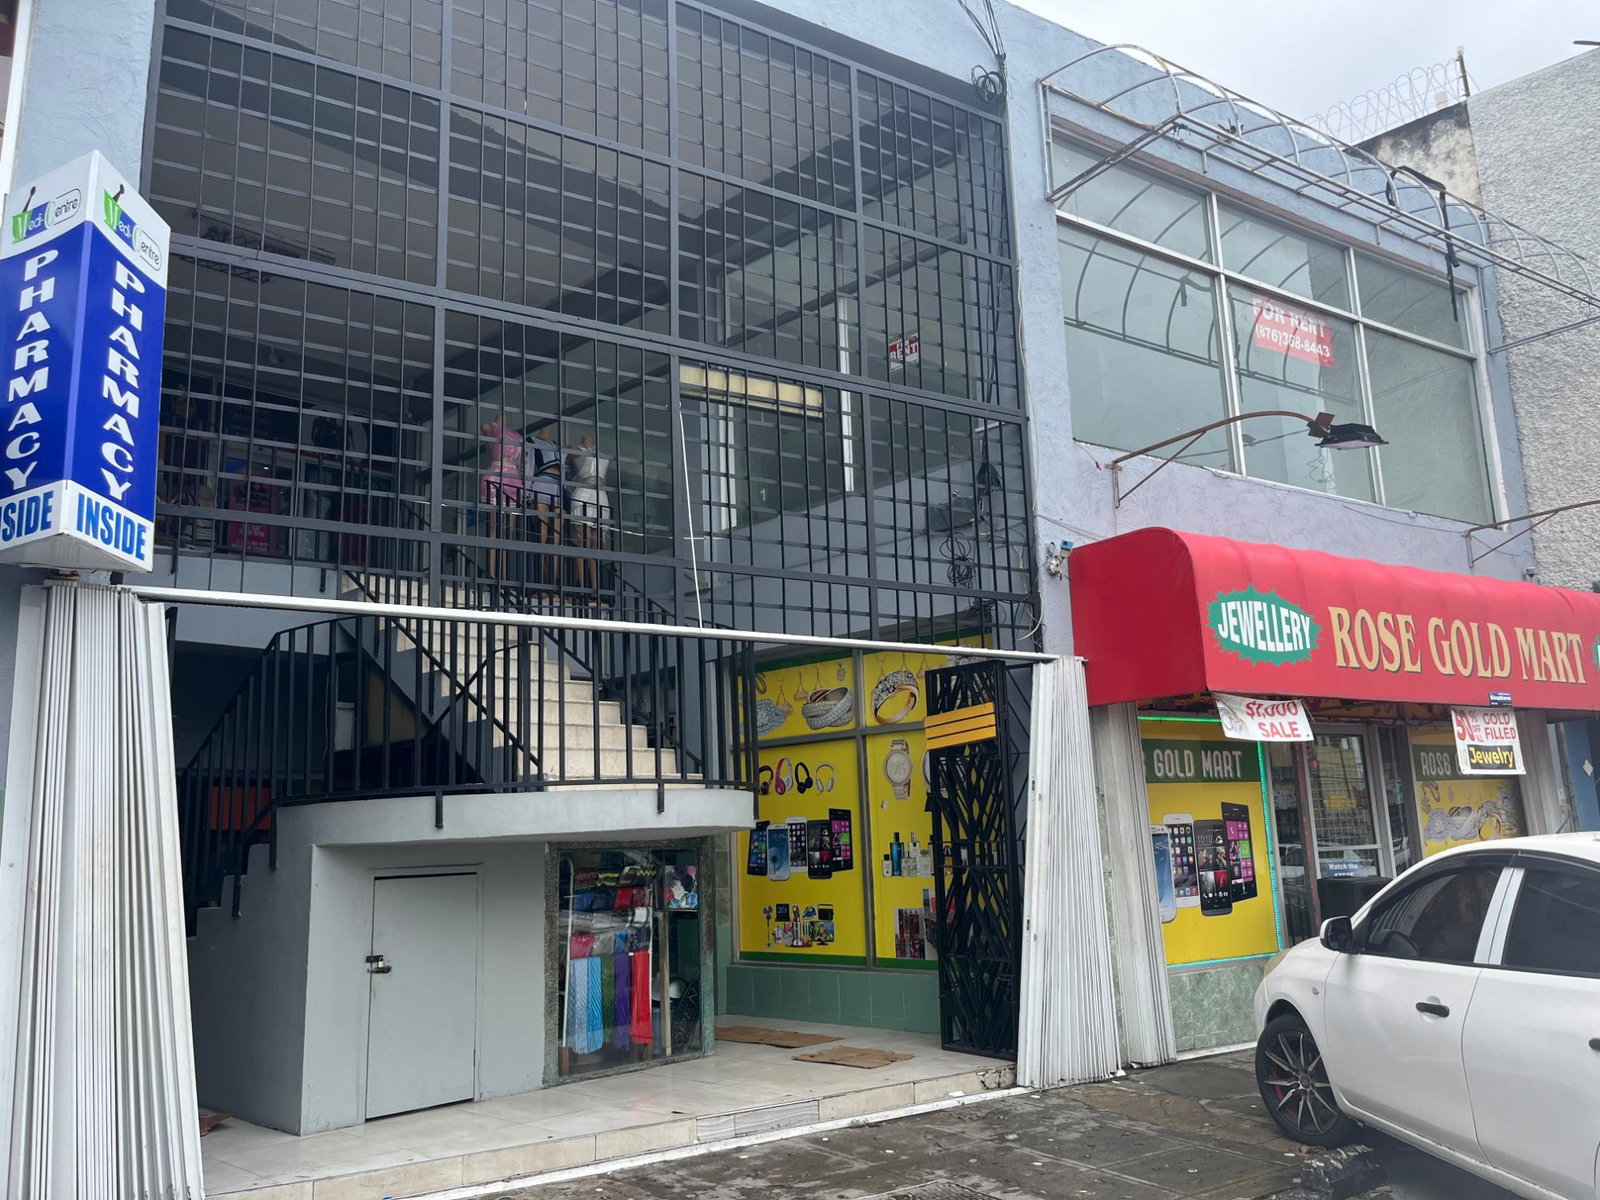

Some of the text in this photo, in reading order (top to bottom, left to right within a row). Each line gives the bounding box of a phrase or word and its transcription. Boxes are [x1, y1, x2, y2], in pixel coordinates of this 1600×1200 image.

[1252, 298, 1326, 338] FOR RENT
[5, 250, 59, 490] PHARMACY
[101, 260, 146, 501] PHARMACY
[0, 491, 54, 542] SIDE
[76, 492, 147, 561] INSIDE
[1217, 600, 1311, 652] JEWELLERY
[1327, 606, 1587, 684] ROSE GOLD MART
[1258, 721, 1301, 738] SALE
[1483, 712, 1511, 725] GOLD
[1484, 727, 1517, 740] FILLED
[1153, 749, 1195, 778] GOLD
[1201, 750, 1243, 779] MART
[1469, 746, 1514, 768] Jewelry
[1328, 862, 1347, 871] Watch
